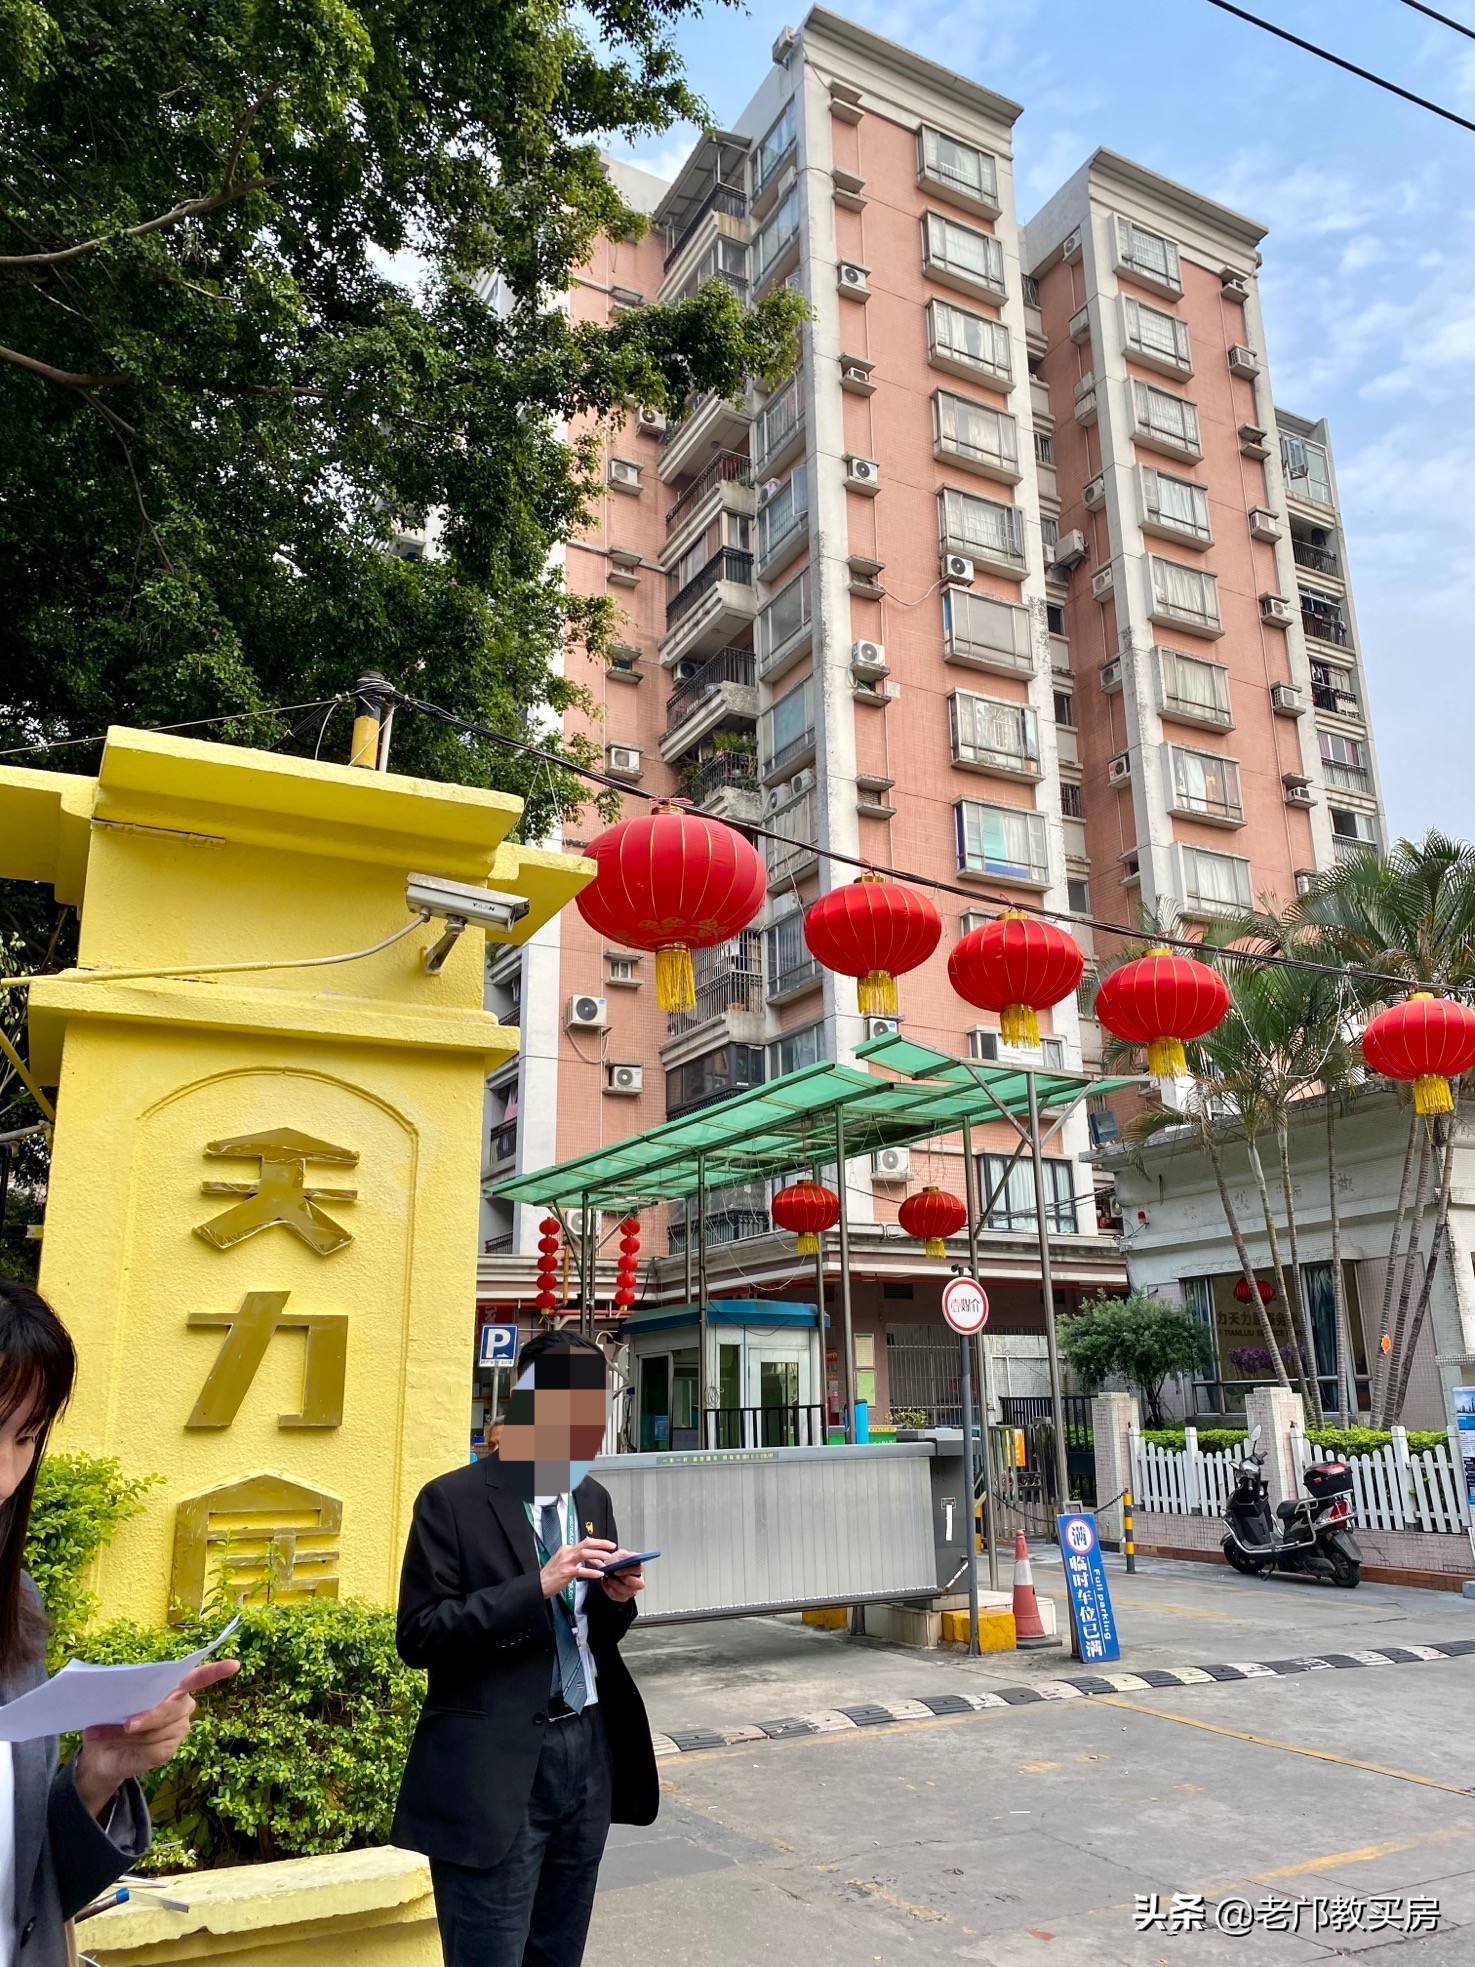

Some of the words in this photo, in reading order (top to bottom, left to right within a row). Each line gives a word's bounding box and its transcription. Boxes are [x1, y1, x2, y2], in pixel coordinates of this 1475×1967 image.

[486, 1328, 511, 1359] P
[168, 1126, 361, 1625] 天力居
[1072, 1526, 1088, 1547] 满
[1094, 1569, 1104, 1591] Full
[1069, 1555, 1103, 1658] 临时车位已满
[1097, 1594, 1112, 1640] parking
